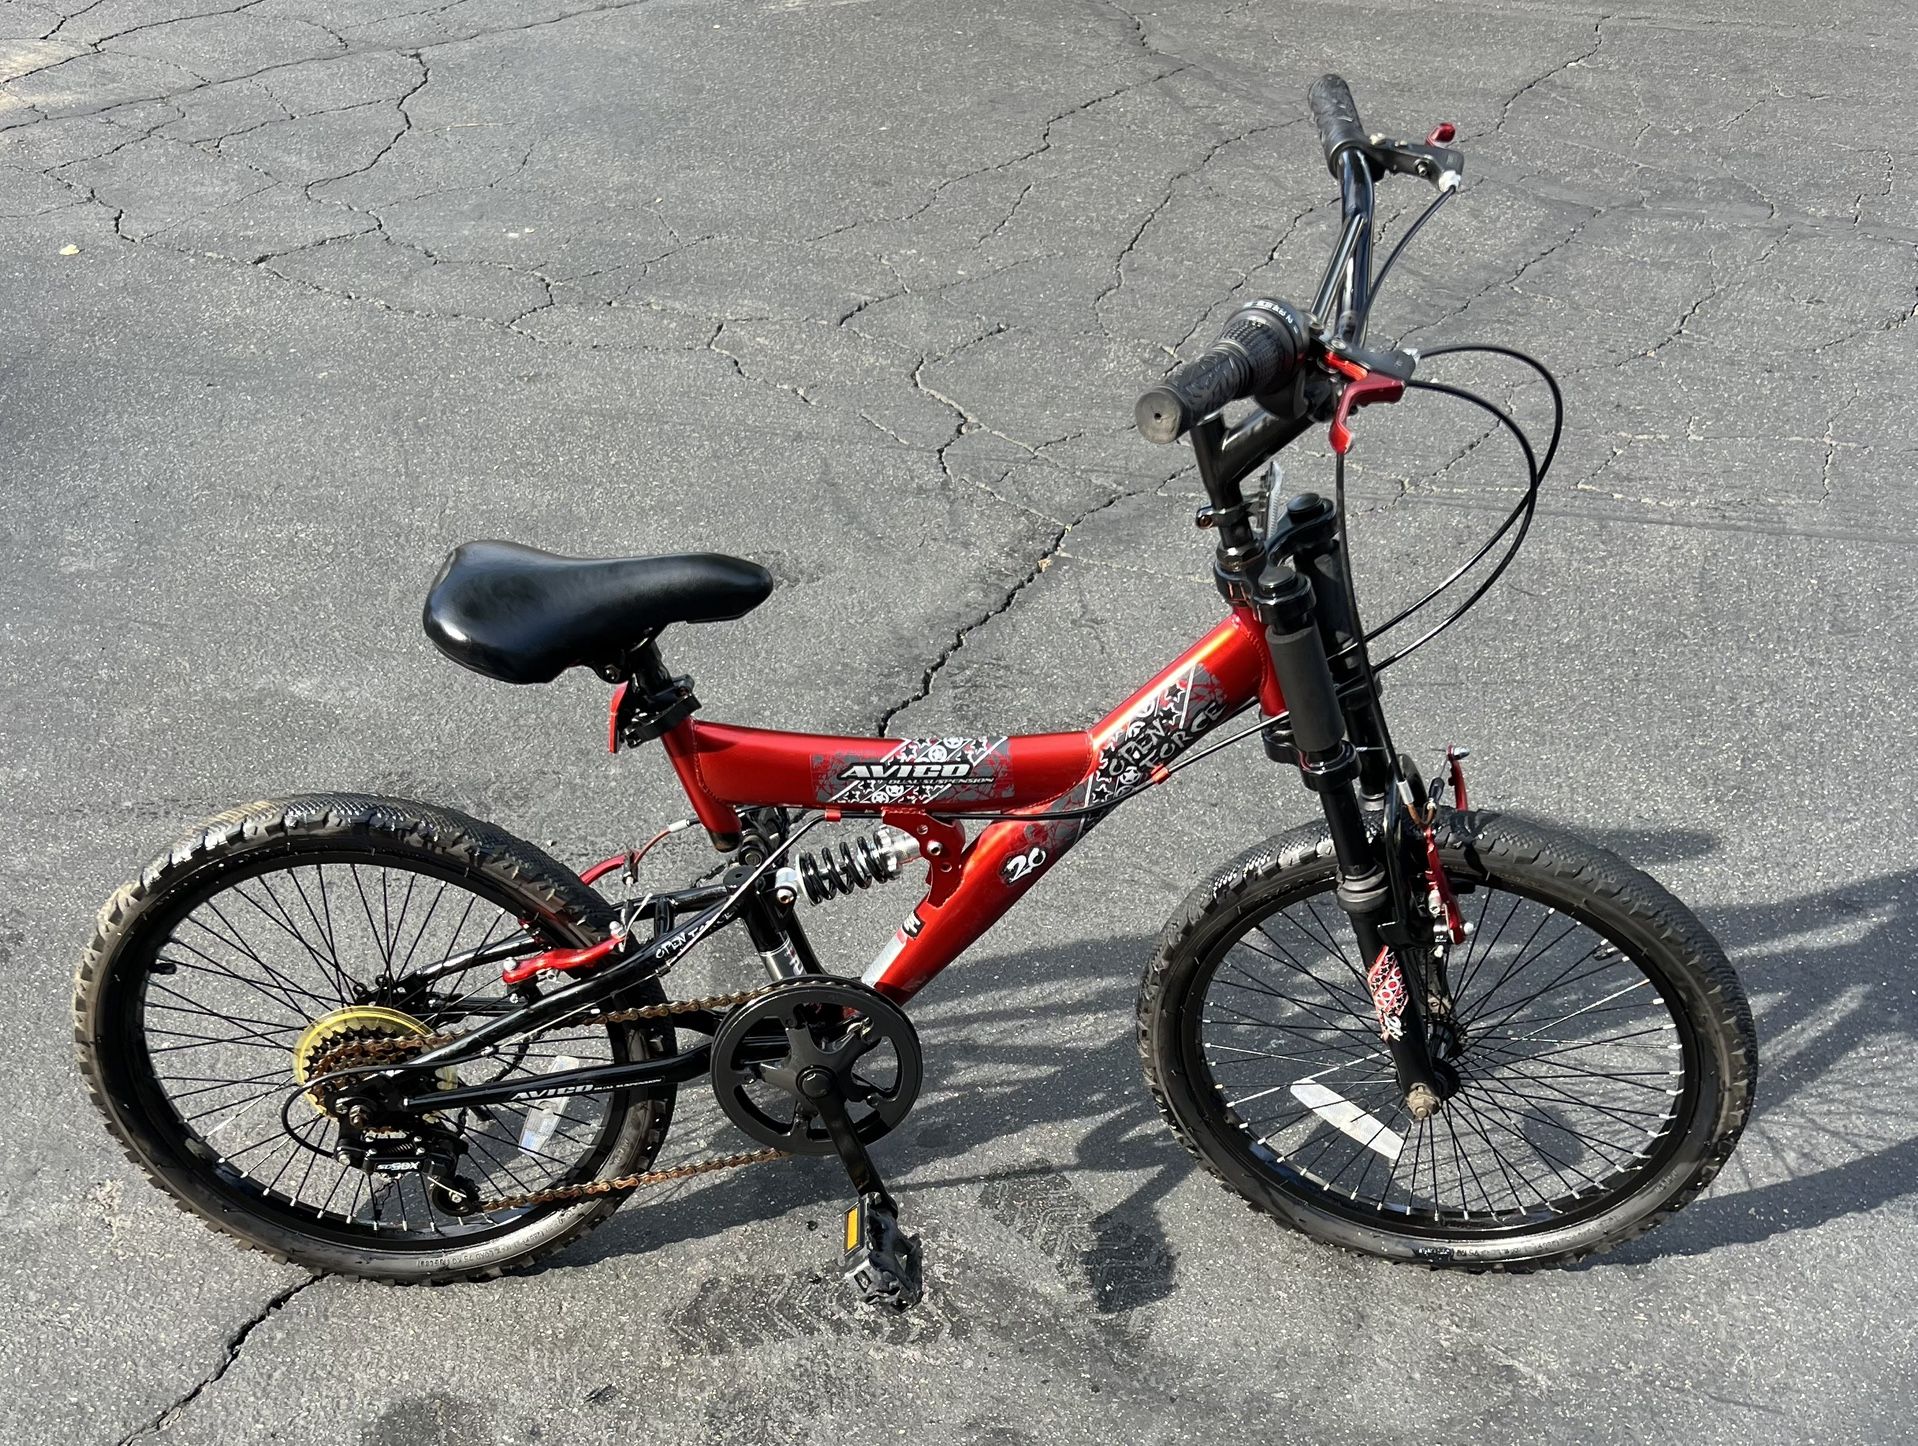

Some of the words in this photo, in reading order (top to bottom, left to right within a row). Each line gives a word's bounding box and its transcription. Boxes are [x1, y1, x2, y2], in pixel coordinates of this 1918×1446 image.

[1139, 701, 1226, 770] FORCE
[1108, 718, 1168, 777] OPEN
[840, 763, 971, 778] AVIGO
[922, 777, 995, 785] SUSPENSION
[655, 931, 688, 959] OPEN
[511, 1084, 594, 1101] AVIGO
